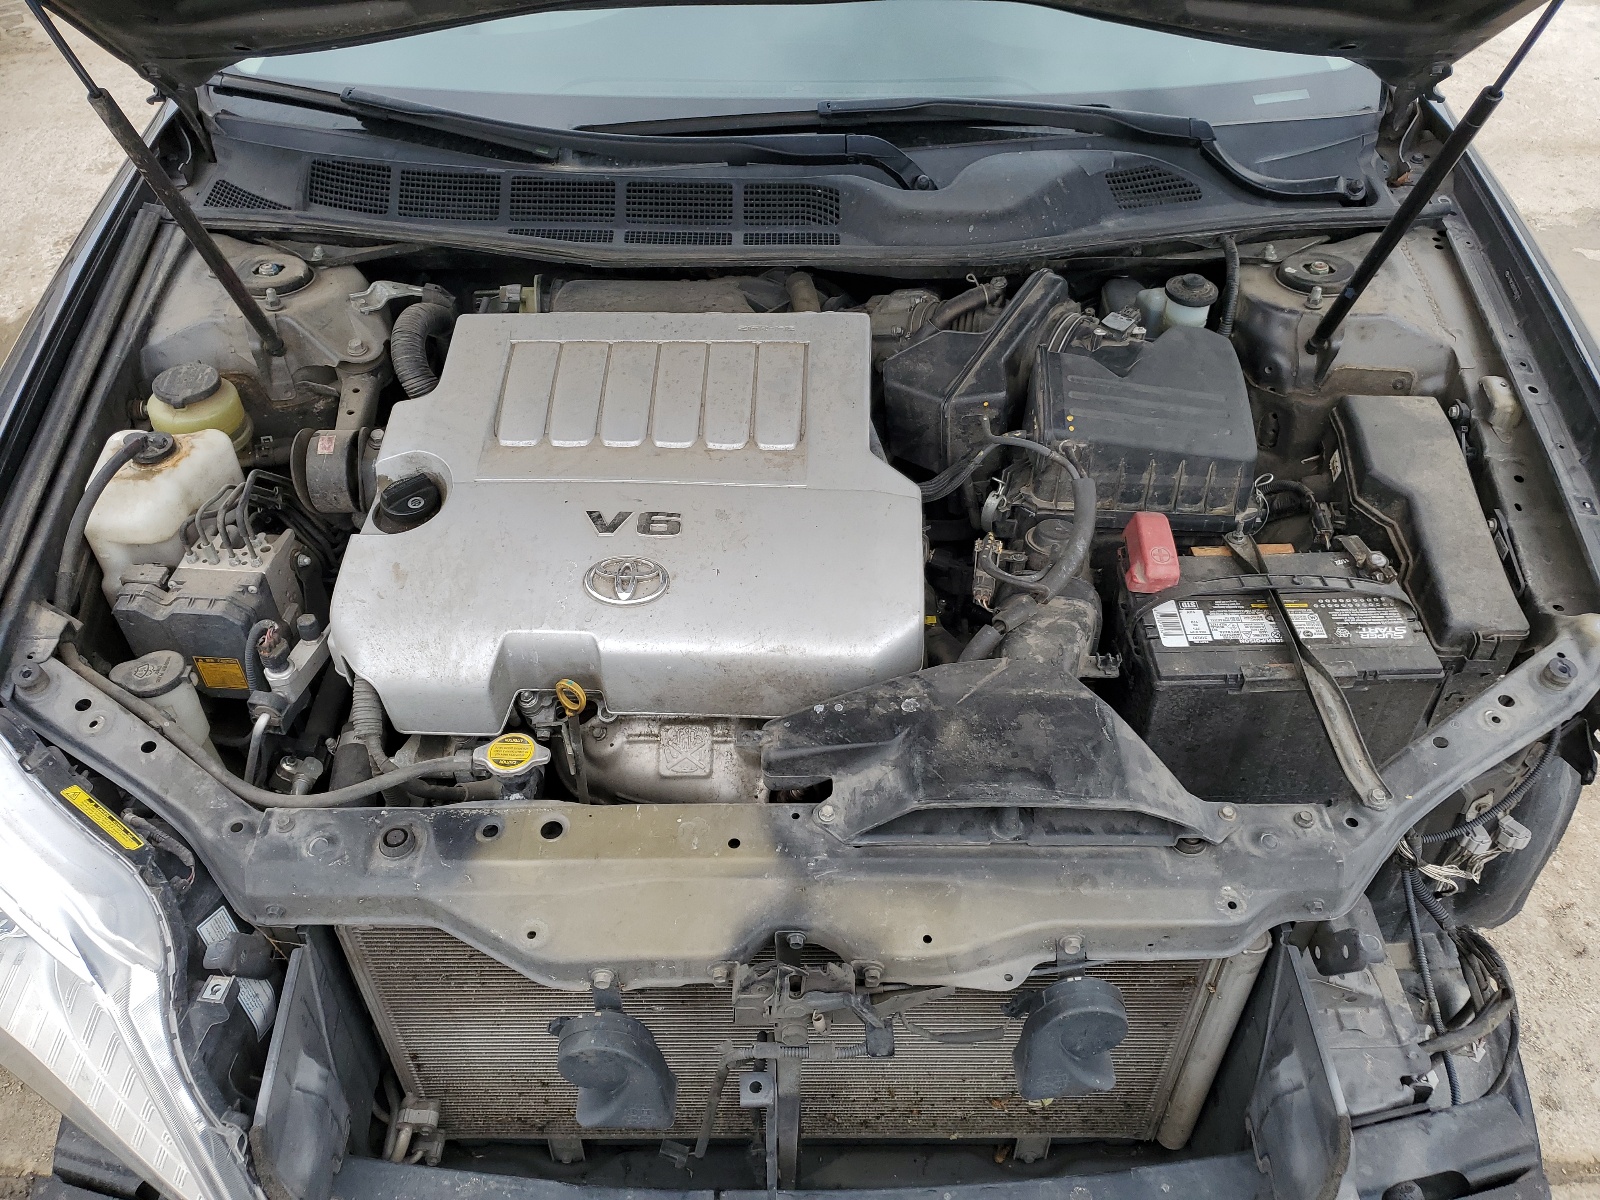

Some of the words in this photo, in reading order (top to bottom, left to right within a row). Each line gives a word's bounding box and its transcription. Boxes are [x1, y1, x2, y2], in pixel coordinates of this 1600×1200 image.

[585, 510, 682, 538] V6
[1358, 626, 1407, 634] START
[1360, 632, 1405, 640] SUPER
